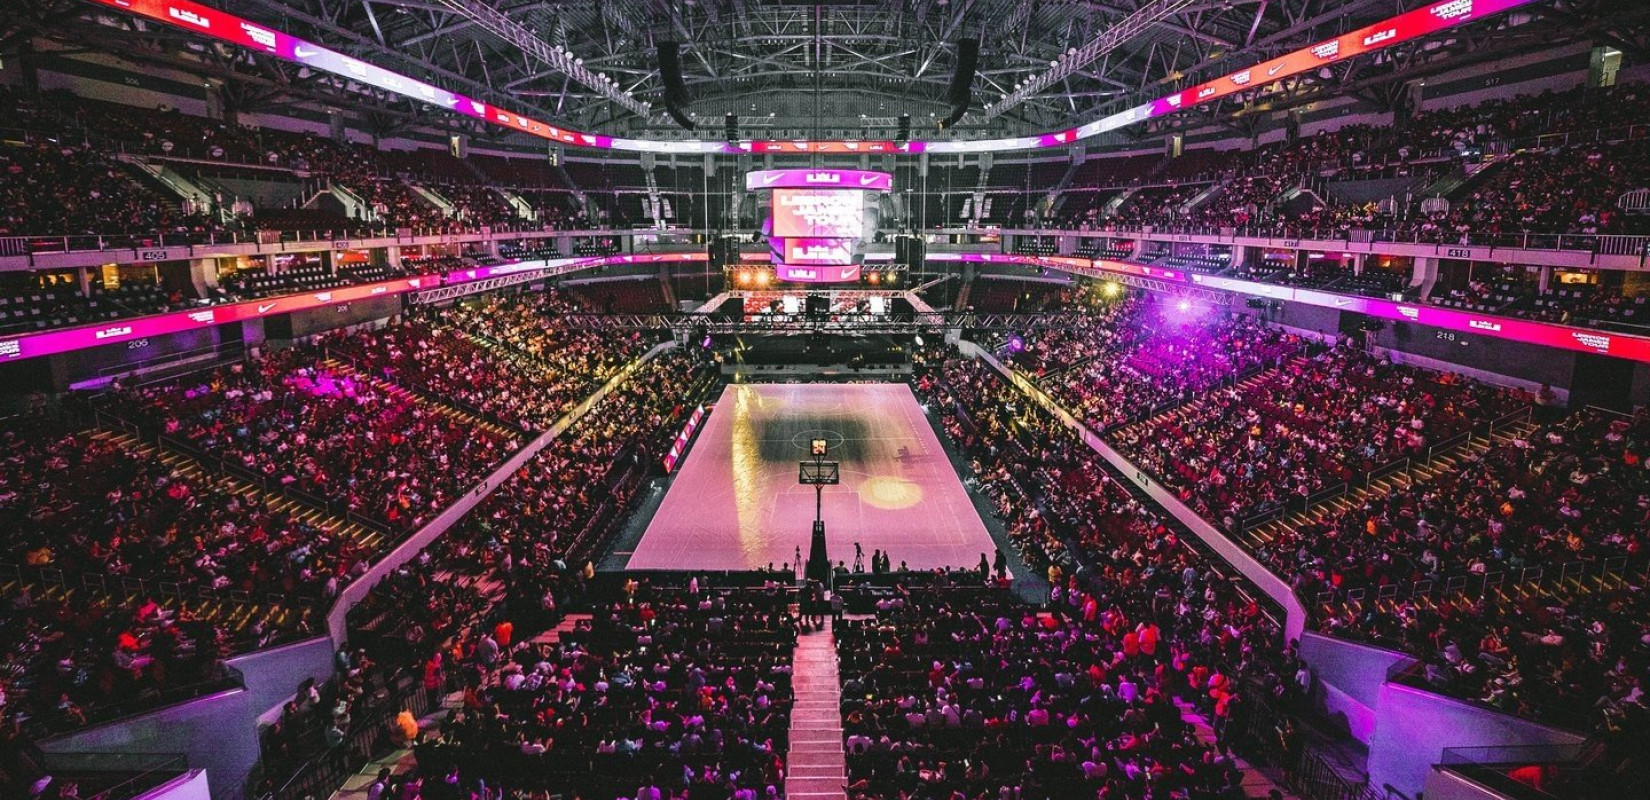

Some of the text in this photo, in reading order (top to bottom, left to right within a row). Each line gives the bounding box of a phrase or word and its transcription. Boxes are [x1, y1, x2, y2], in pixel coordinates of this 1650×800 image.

[1485, 77, 1500, 86] 517
[145, 251, 165, 260] 405
[1449, 249, 1469, 258] 418
[1436, 330, 1455, 341] 218
[812, 439, 827, 455] 24
